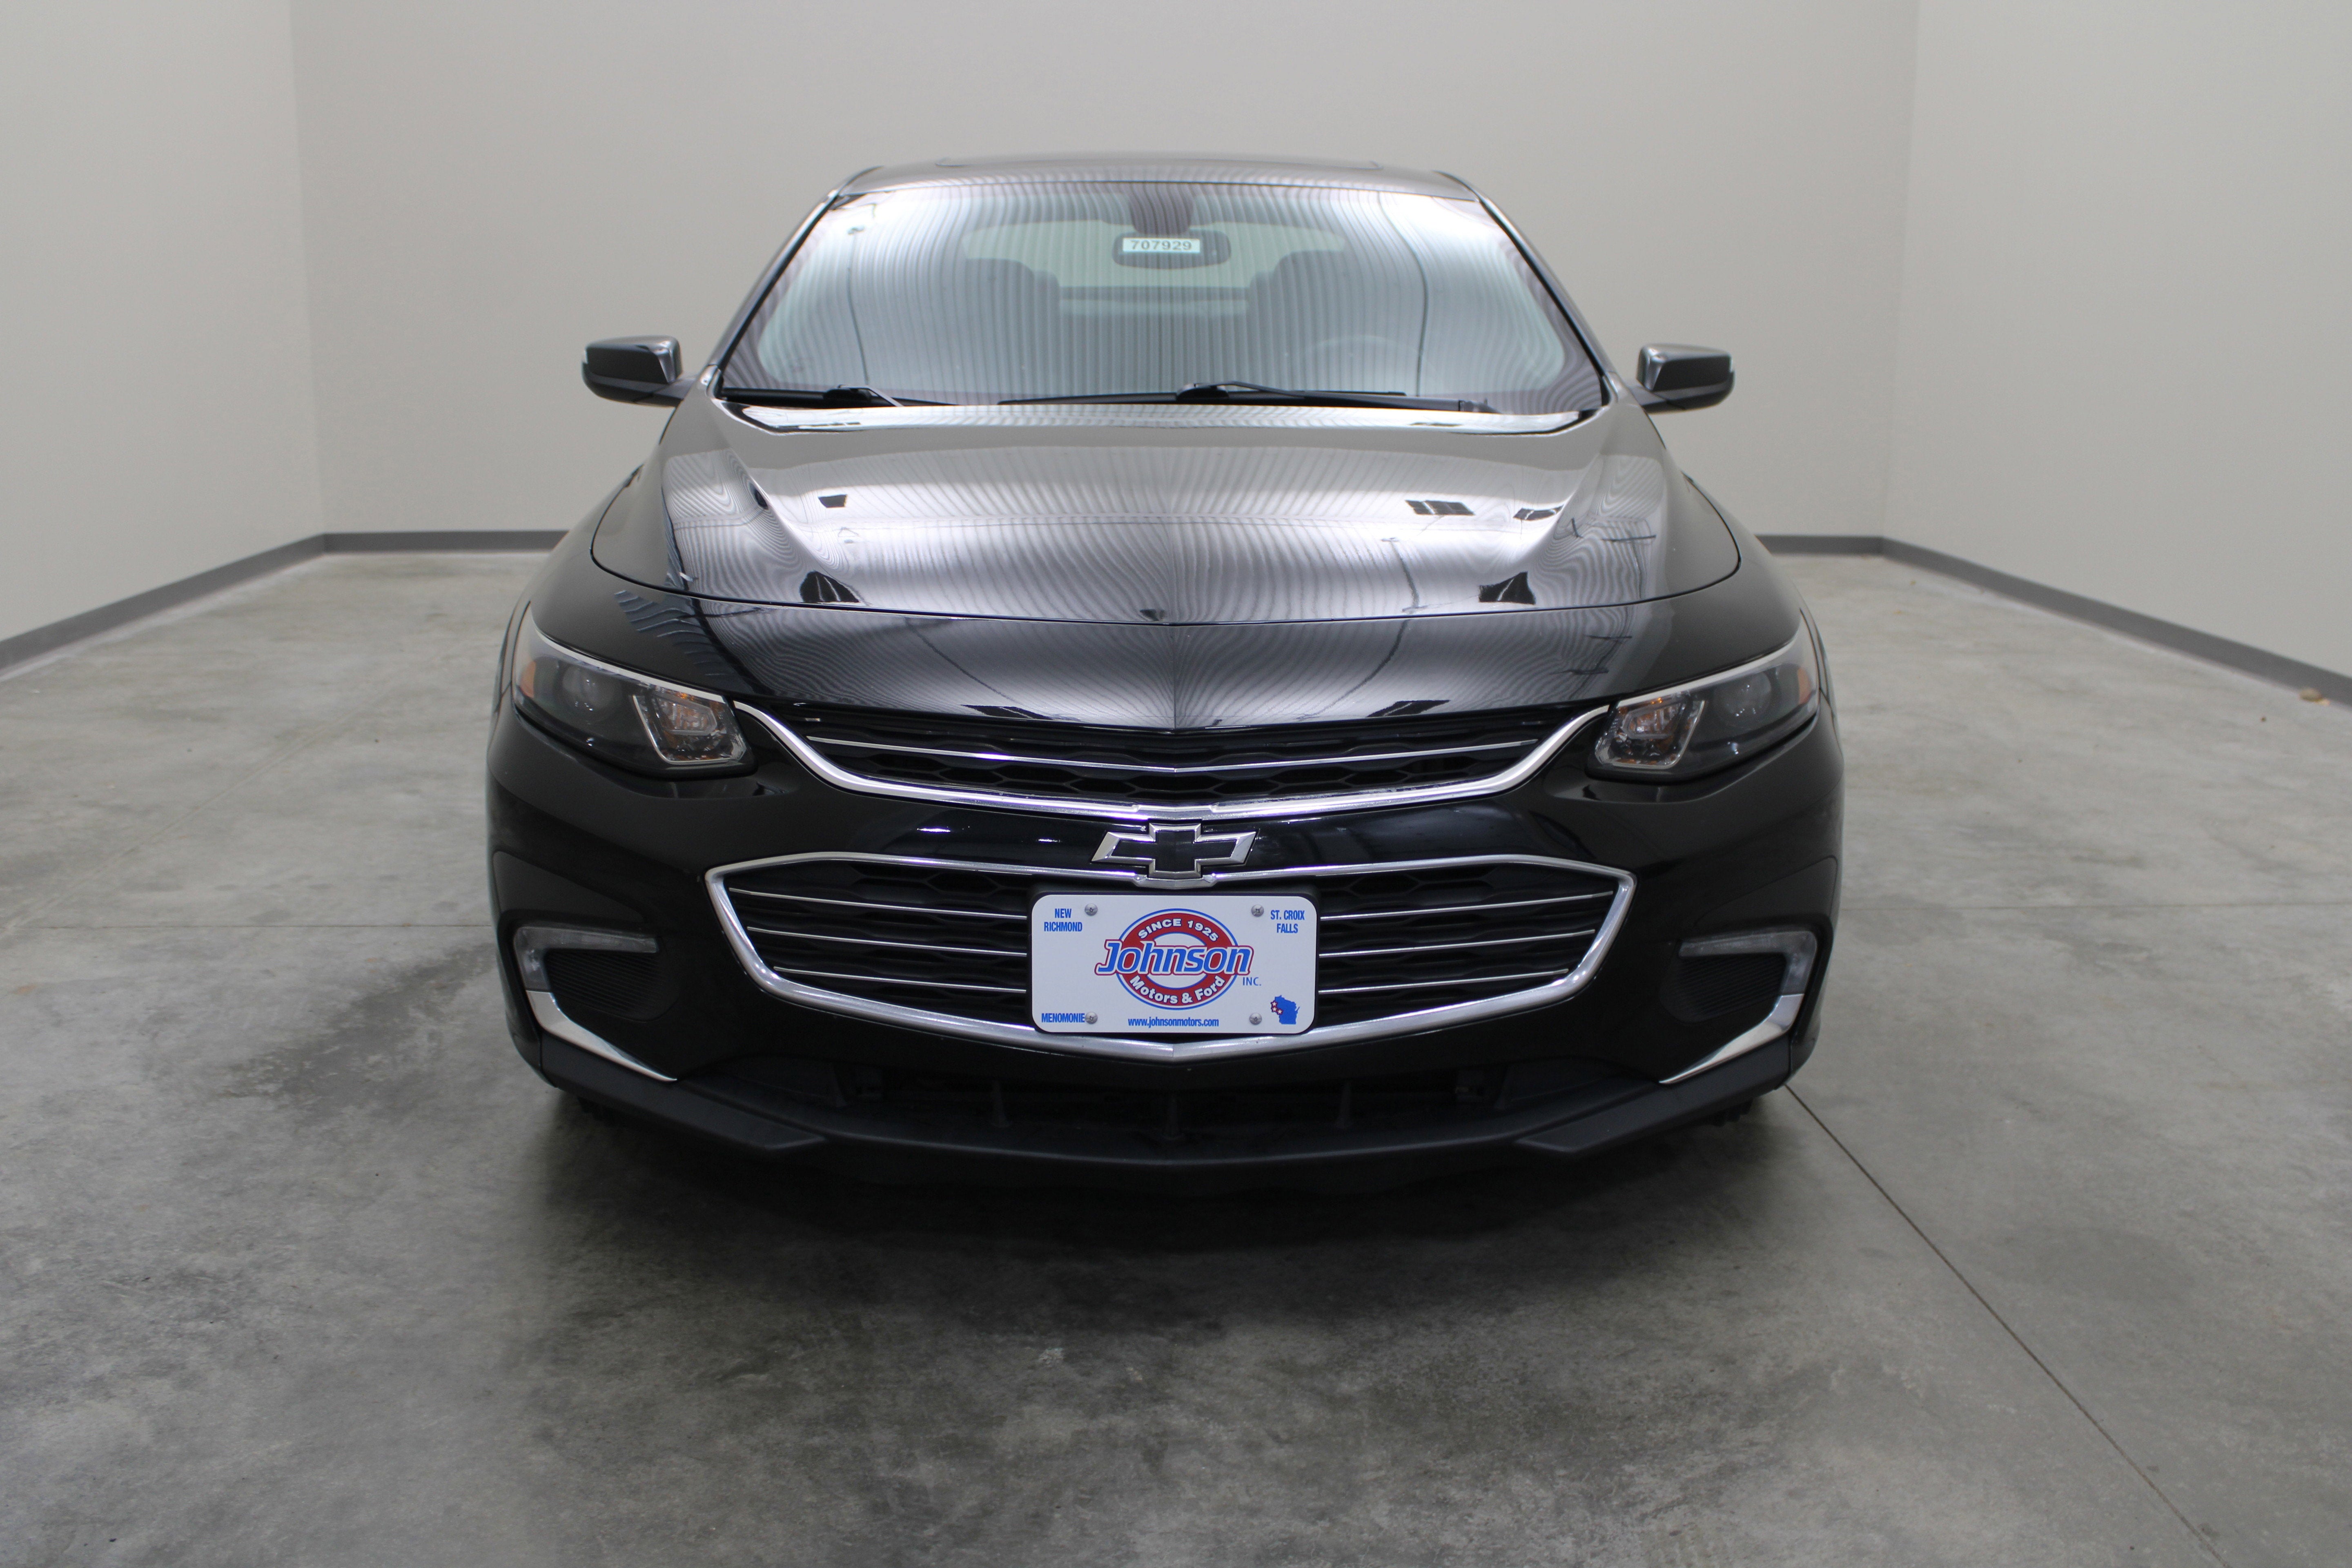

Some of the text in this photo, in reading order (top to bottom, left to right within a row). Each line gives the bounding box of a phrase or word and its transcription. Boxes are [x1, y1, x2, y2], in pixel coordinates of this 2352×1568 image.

[1131, 240, 1192, 250] 707929
[1055, 908, 1071, 918] NEW
[1270, 910, 1305, 920] ST. CROIX
[1044, 922, 1083, 932] RICHMOND
[1138, 918, 1219, 942] SINCE 1925
[1276, 923, 1298, 933] FALLS
[1096, 941, 1252, 973] Johnson
[1243, 977, 1262, 986] INC.
[1129, 975, 1225, 1004] Motors & Ford
[1041, 1013, 1085, 1023] MENOMONIE
[1128, 1017, 1219, 1028] www.johnsonmotors.com
